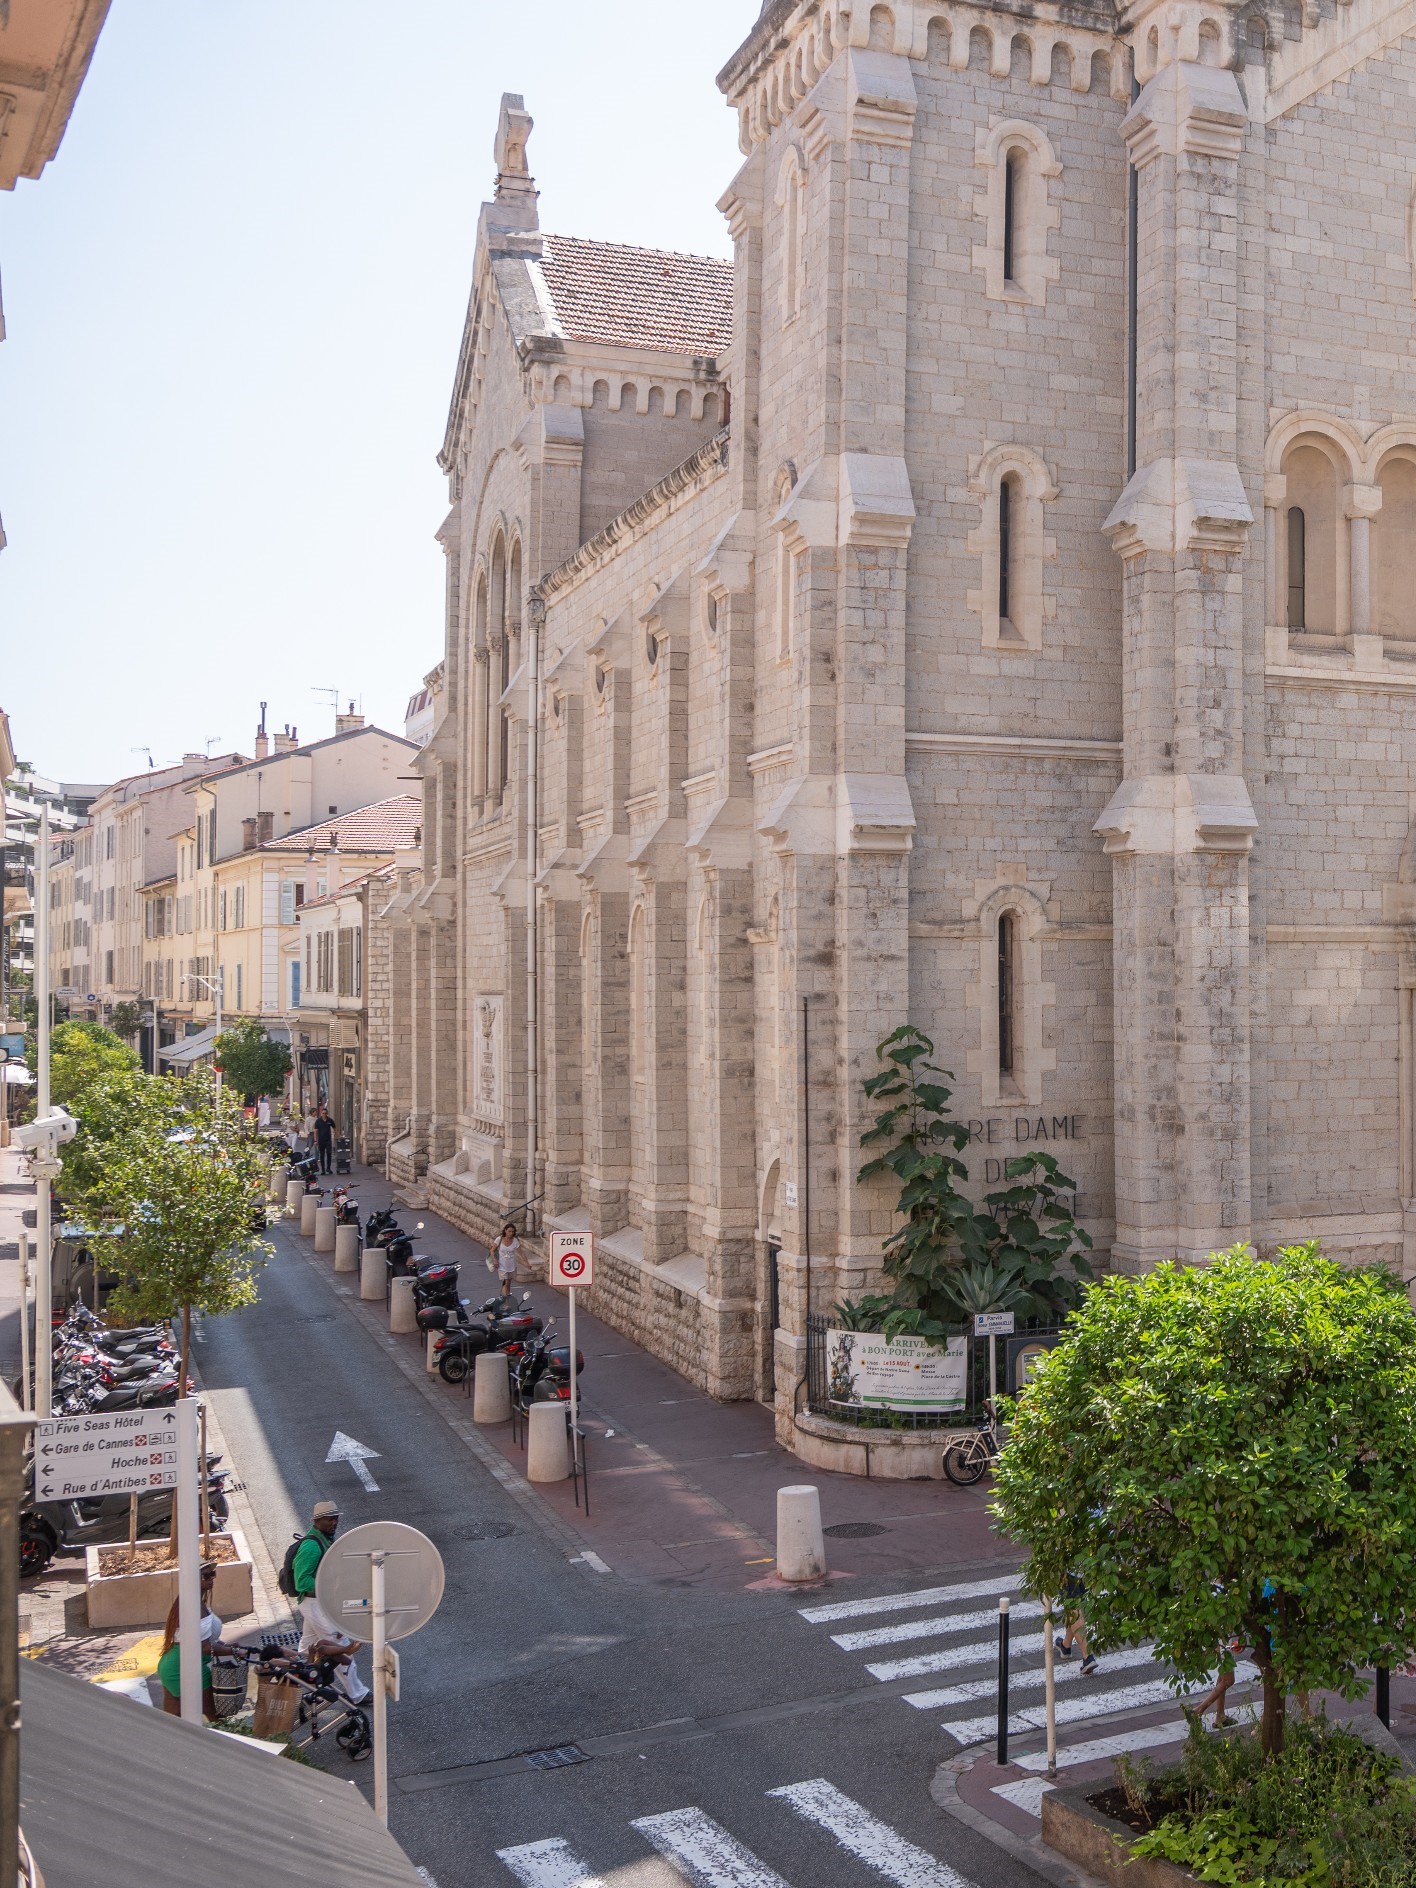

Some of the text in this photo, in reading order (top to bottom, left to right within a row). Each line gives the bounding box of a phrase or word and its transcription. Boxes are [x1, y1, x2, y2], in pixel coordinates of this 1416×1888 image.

[1014, 1114, 1087, 1142] DAME
[560, 1237, 585, 1246] ZONE
[564, 1259, 581, 1271] 30
[890, 1339, 931, 1348] ARRIVE
[868, 1346, 887, 1354] BON
[889, 1347, 915, 1356] PORT
[917, 1350, 936, 1358] avec
[56, 1415, 144, 1434] Five Seas Hôtel
[55, 1438, 134, 1454] Gare de Cannes
[111, 1456, 149, 1469] Hoche
[62, 1482, 86, 1494] Rue
